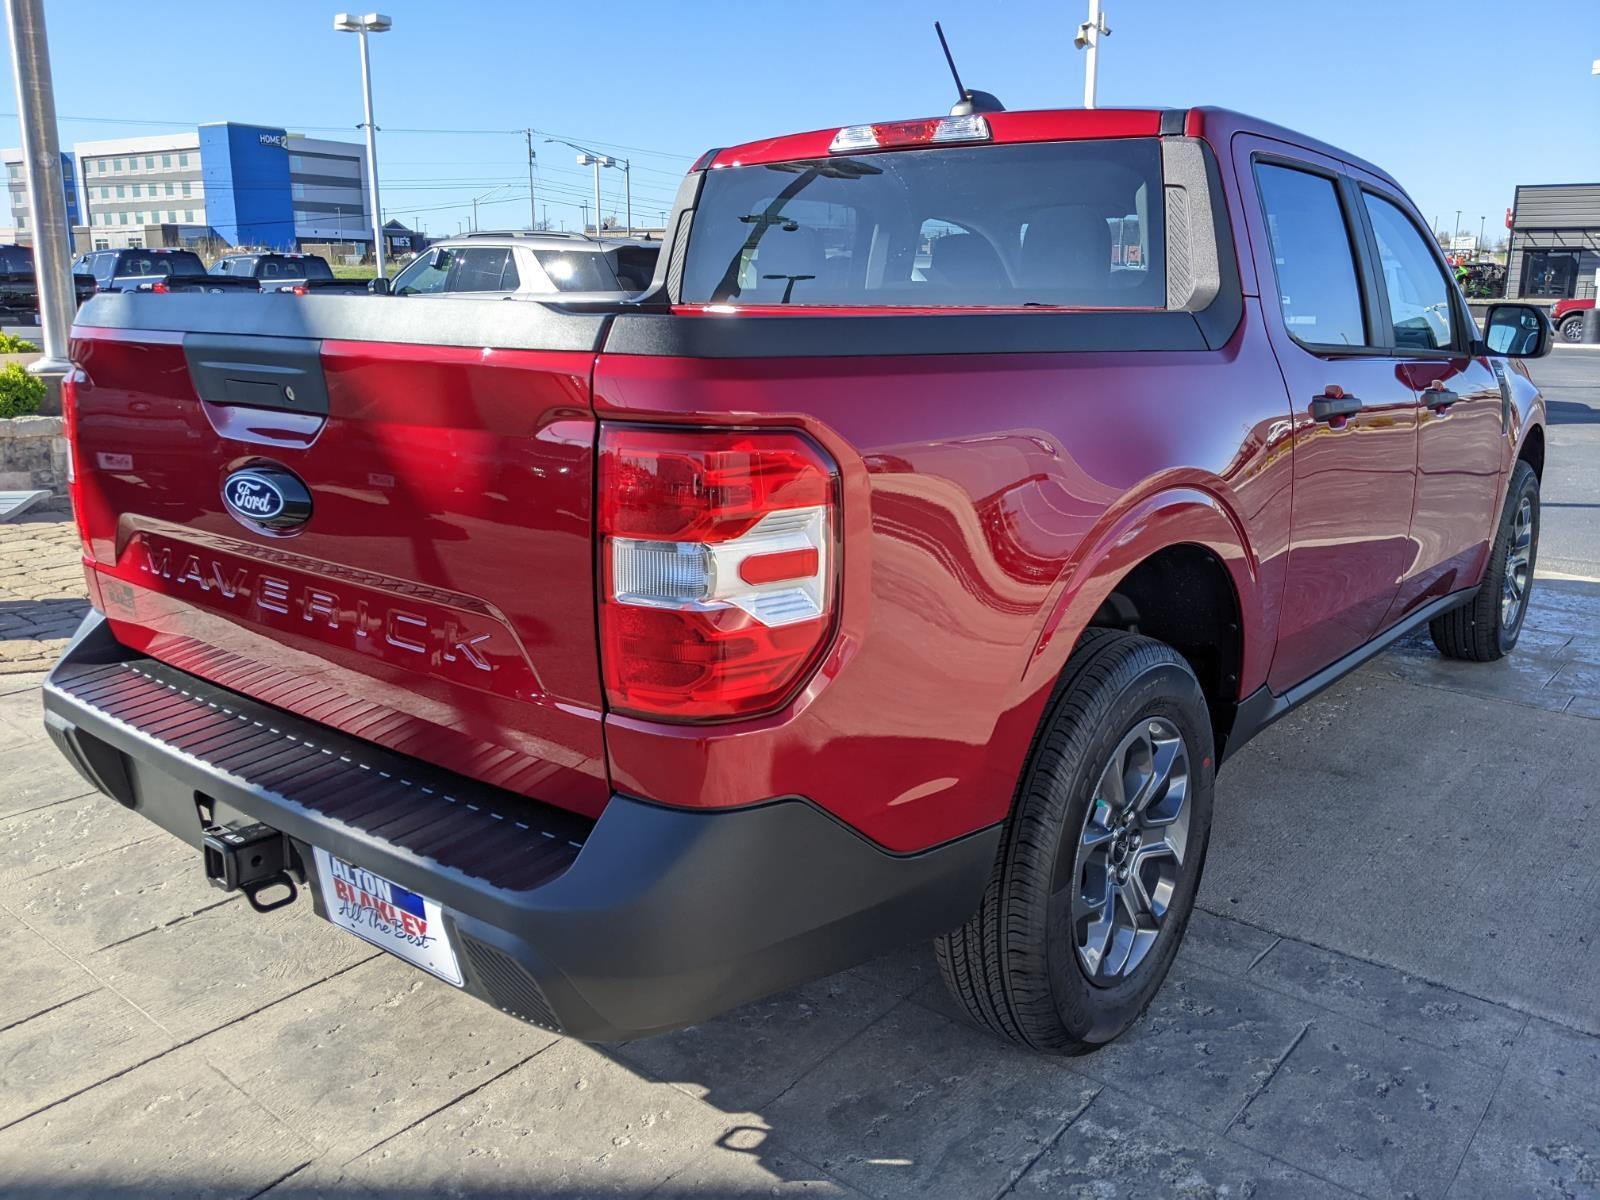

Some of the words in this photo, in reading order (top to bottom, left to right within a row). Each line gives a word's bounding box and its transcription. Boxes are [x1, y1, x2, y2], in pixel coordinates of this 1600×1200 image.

[234, 480, 272, 513] Ford
[140, 541, 493, 671] MAVERICK
[331, 856, 393, 904] ALTON
[333, 877, 428, 937] BLAKLEY
[338, 897, 365, 925] All
[363, 906, 392, 935] The
[390, 918, 437, 950] Best
